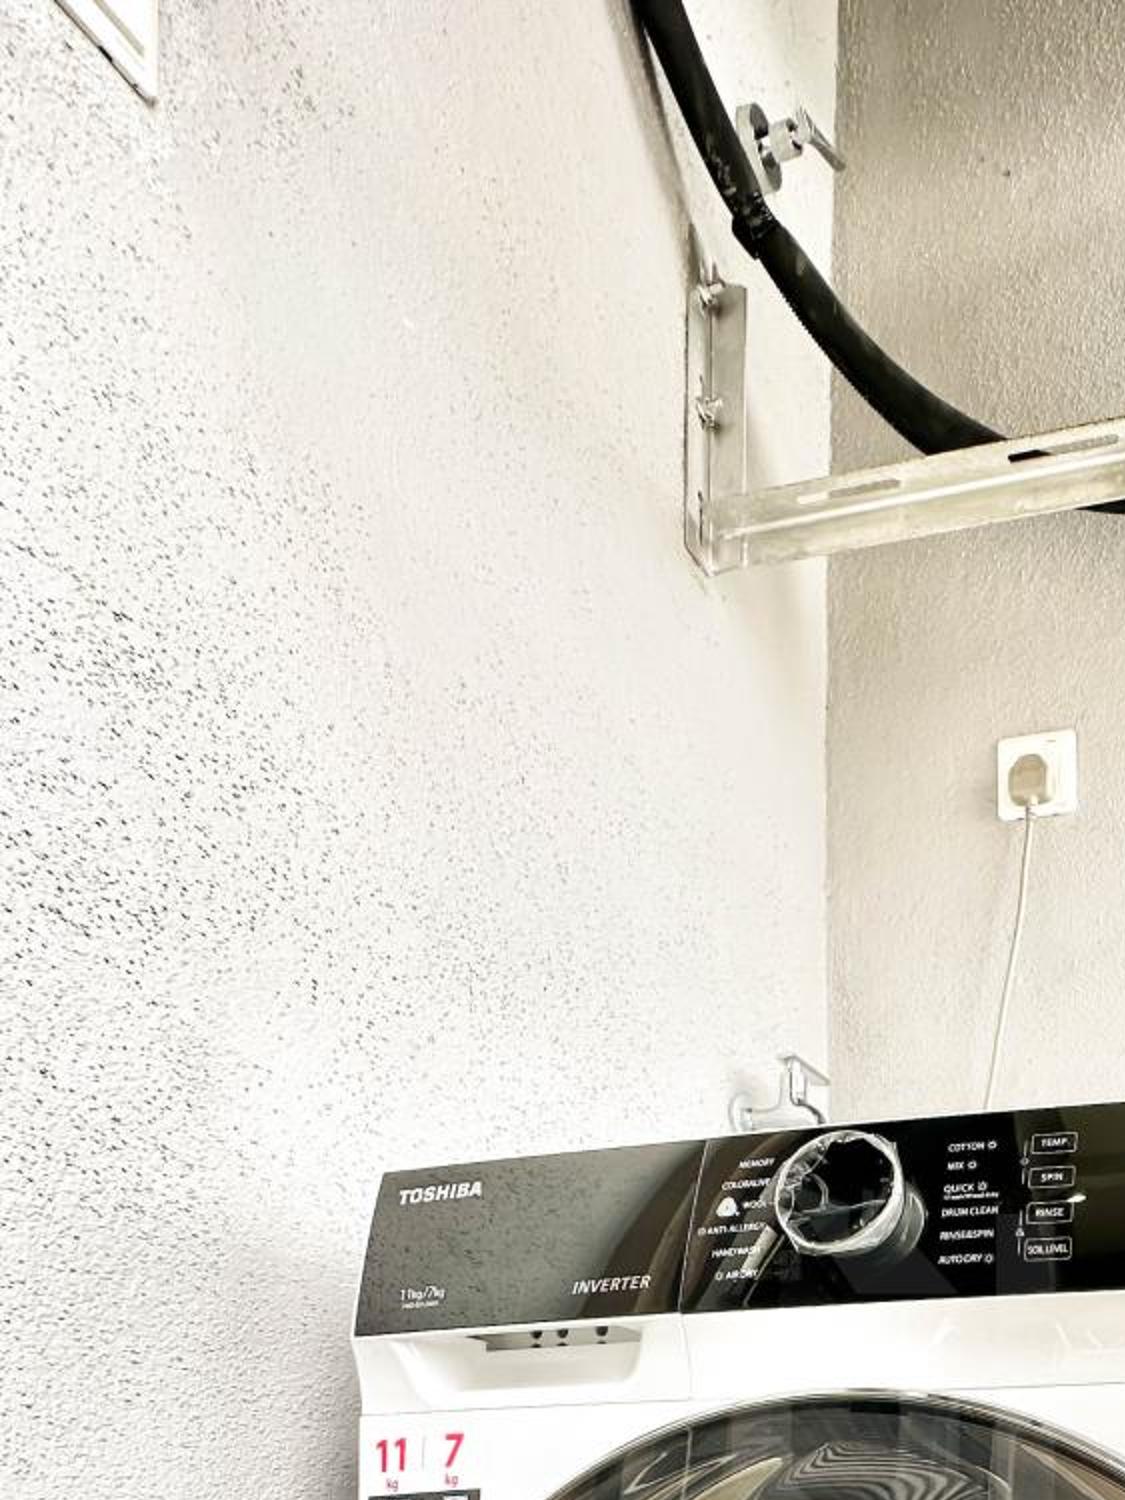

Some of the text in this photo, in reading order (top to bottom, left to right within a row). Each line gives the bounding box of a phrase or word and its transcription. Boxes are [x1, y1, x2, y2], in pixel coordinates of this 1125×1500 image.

[947, 1141, 985, 1152] COTTON
[739, 1157, 775, 1169] MEMORY
[947, 1161, 965, 1170] MIX
[1041, 1172, 1064, 1182] SPIN
[399, 1181, 483, 1205] TOSHIBA
[943, 1183, 975, 1194] QUICK
[969, 1205, 999, 1216] CLEAN
[1035, 1207, 1065, 1217] RINSE
[571, 1274, 652, 1295] INVERTER
[376, 1437, 406, 1473] 11
[445, 1433, 464, 1468] 7
[445, 1474, 458, 1488] kg
